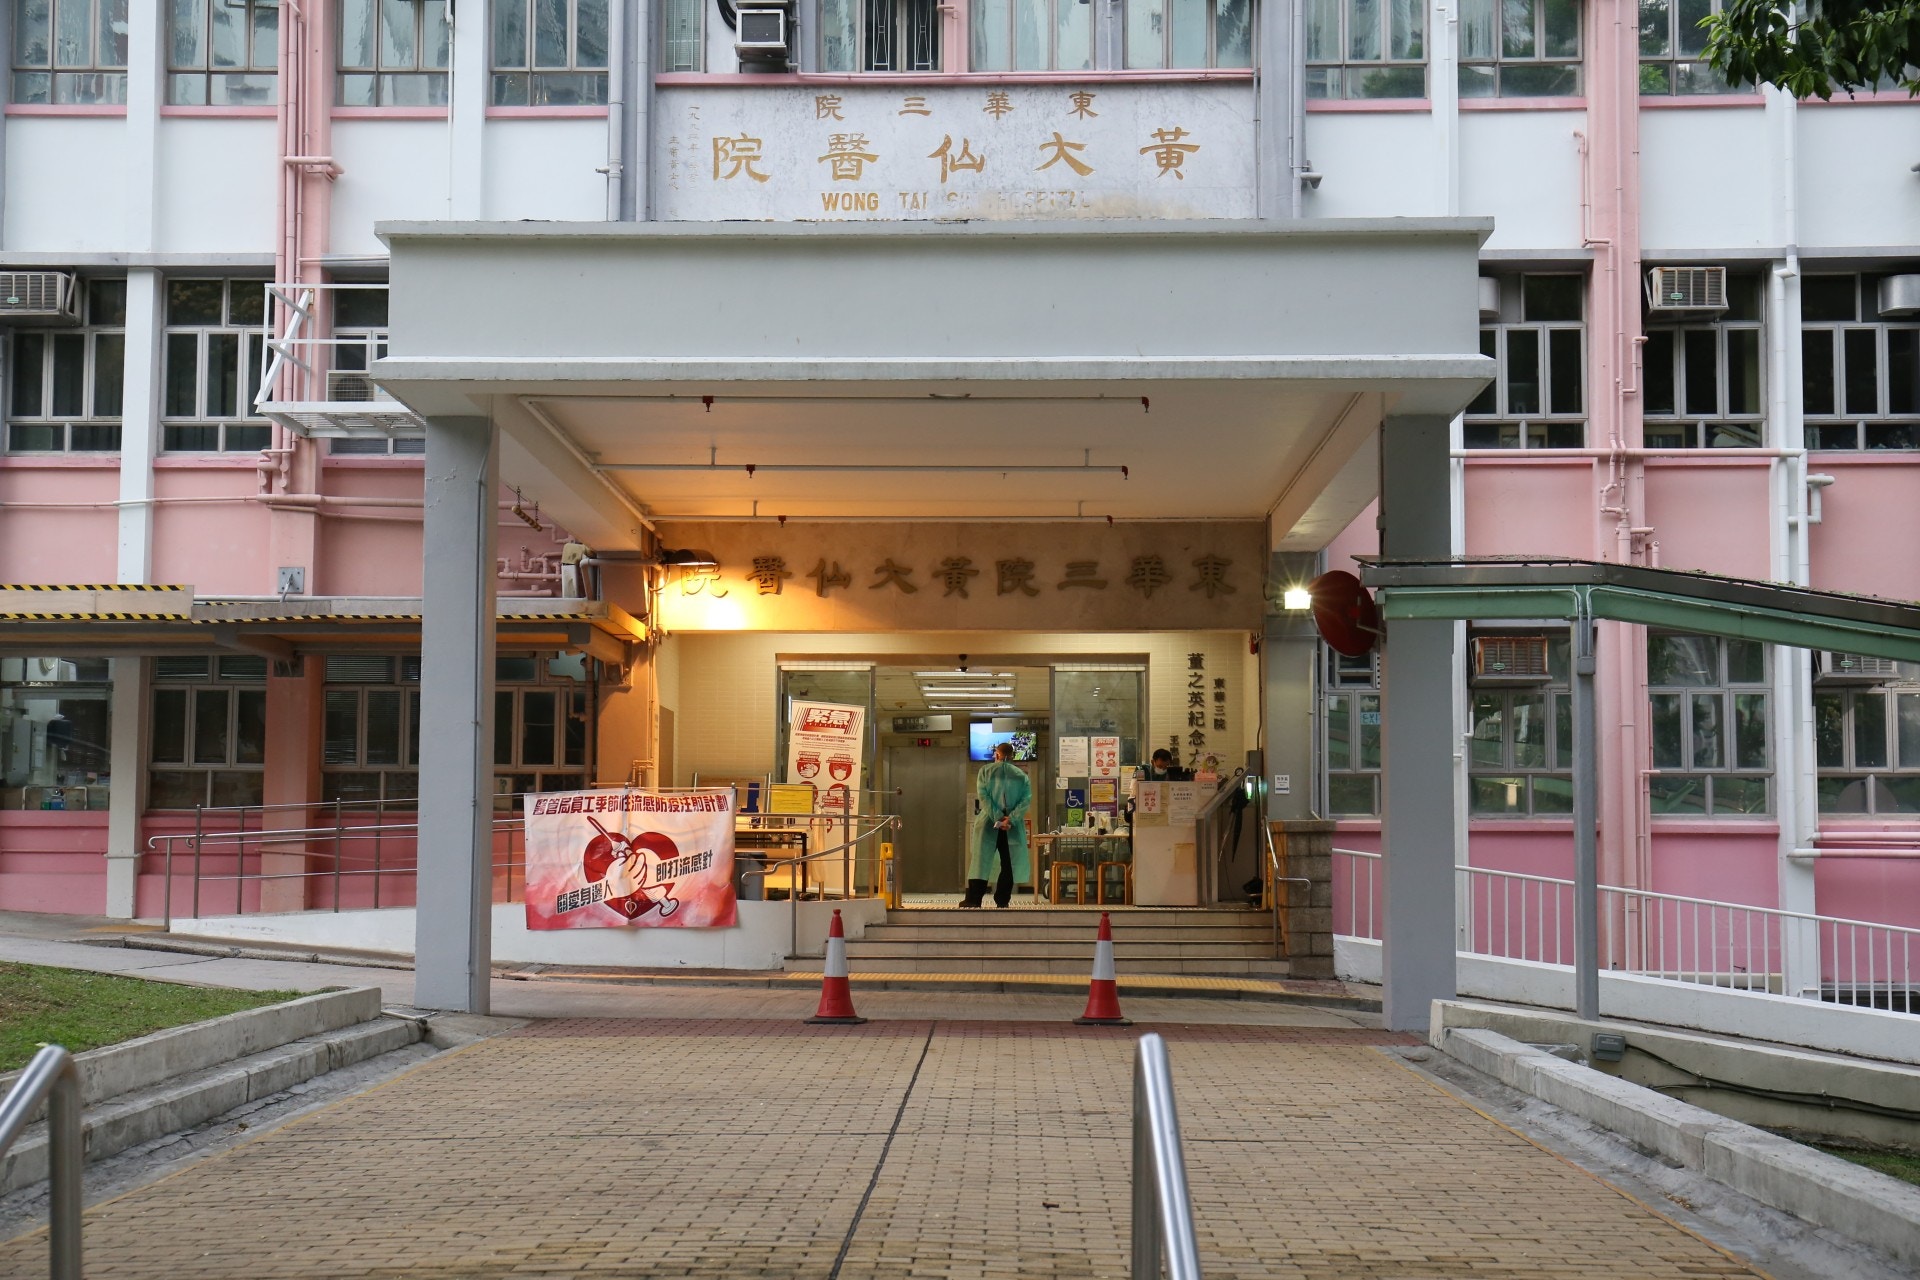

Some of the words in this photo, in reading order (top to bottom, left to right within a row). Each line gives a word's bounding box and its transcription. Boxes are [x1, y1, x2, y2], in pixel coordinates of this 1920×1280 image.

[815, 91, 1099, 121] 東華三院
[712, 127, 1200, 183] 黃大仙醫院
[821, 192, 879, 211] WONG
[899, 192, 928, 210] TAI
[680, 553, 1236, 599] 東華三院黃大仙醫院
[656, 849, 714, 883] 即打流感針
[556, 879, 614, 915] 關愛身邊人
